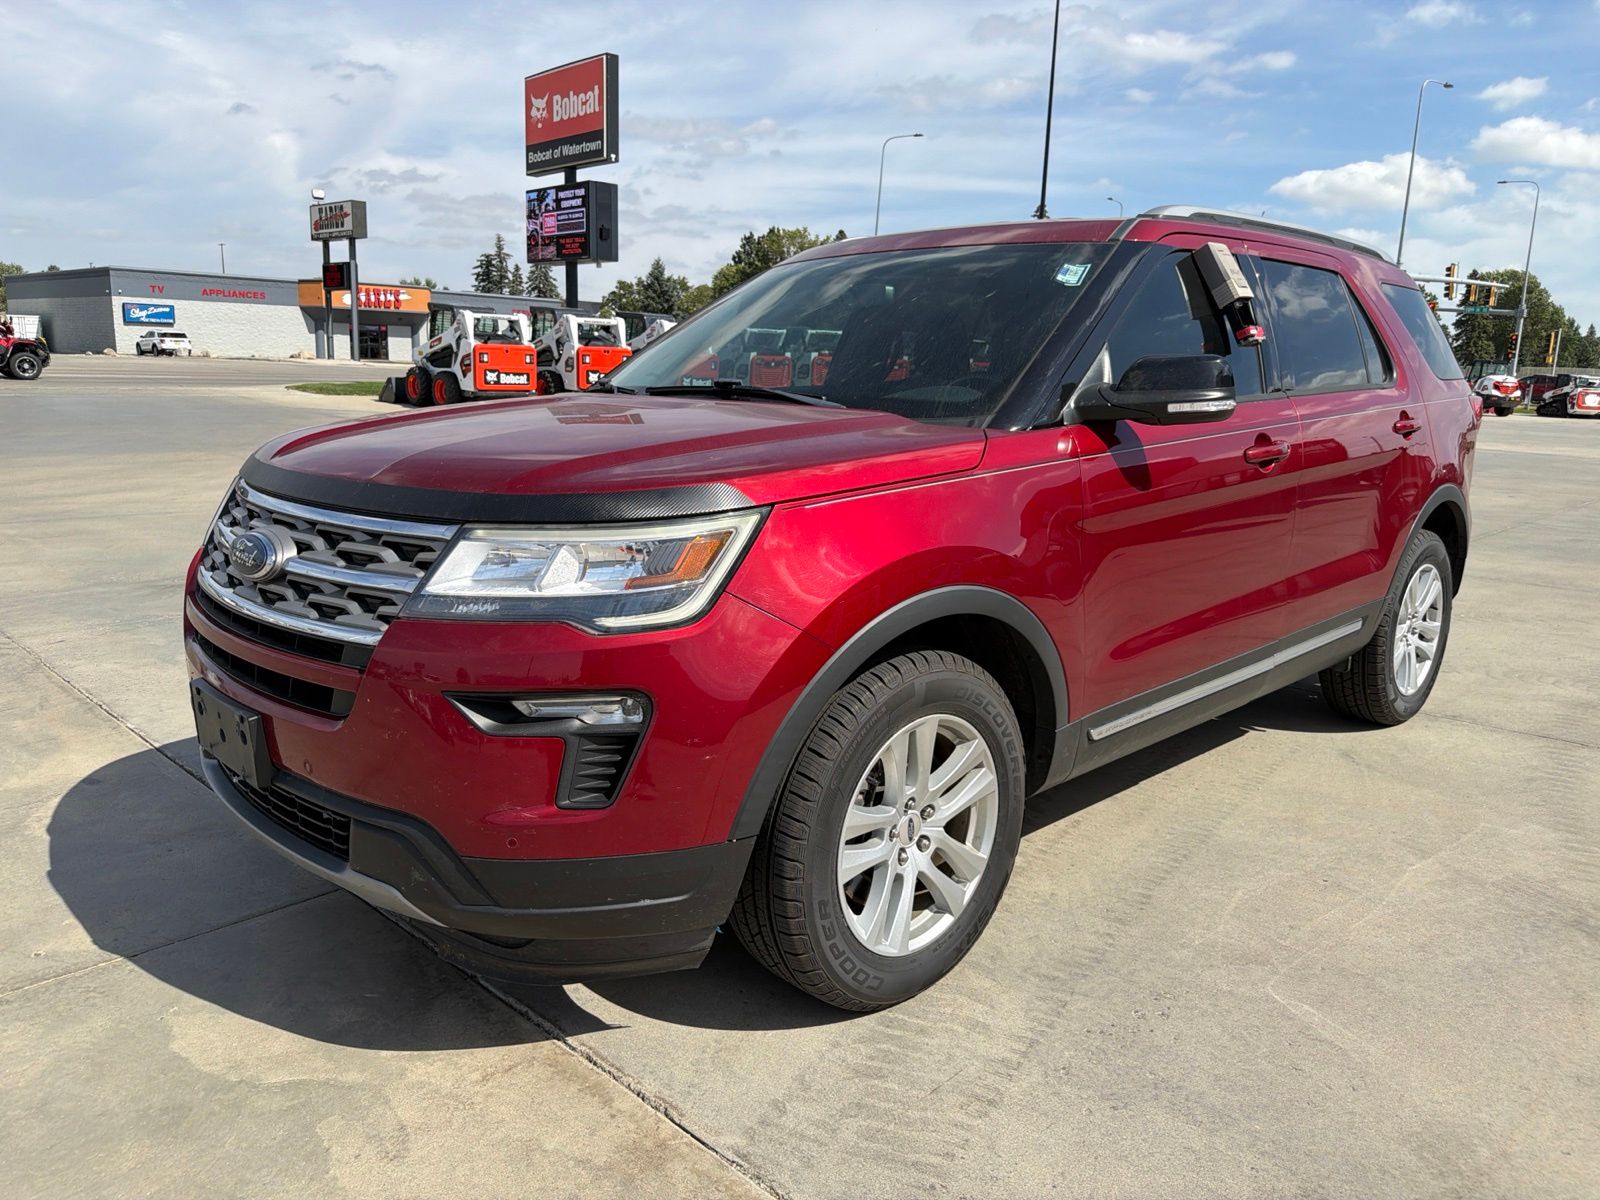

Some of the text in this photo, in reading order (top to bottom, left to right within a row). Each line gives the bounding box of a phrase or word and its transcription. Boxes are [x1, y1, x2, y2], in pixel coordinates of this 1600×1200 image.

[553, 85, 600, 122] Bobcat
[528, 140, 602, 164] Bobcat of Watertown
[149, 284, 164, 294] TV
[201, 288, 266, 300] APPLIANCES
[500, 373, 528, 384] Bobcat
[233, 537, 257, 566] Ford
[817, 899, 885, 992] COOPER
